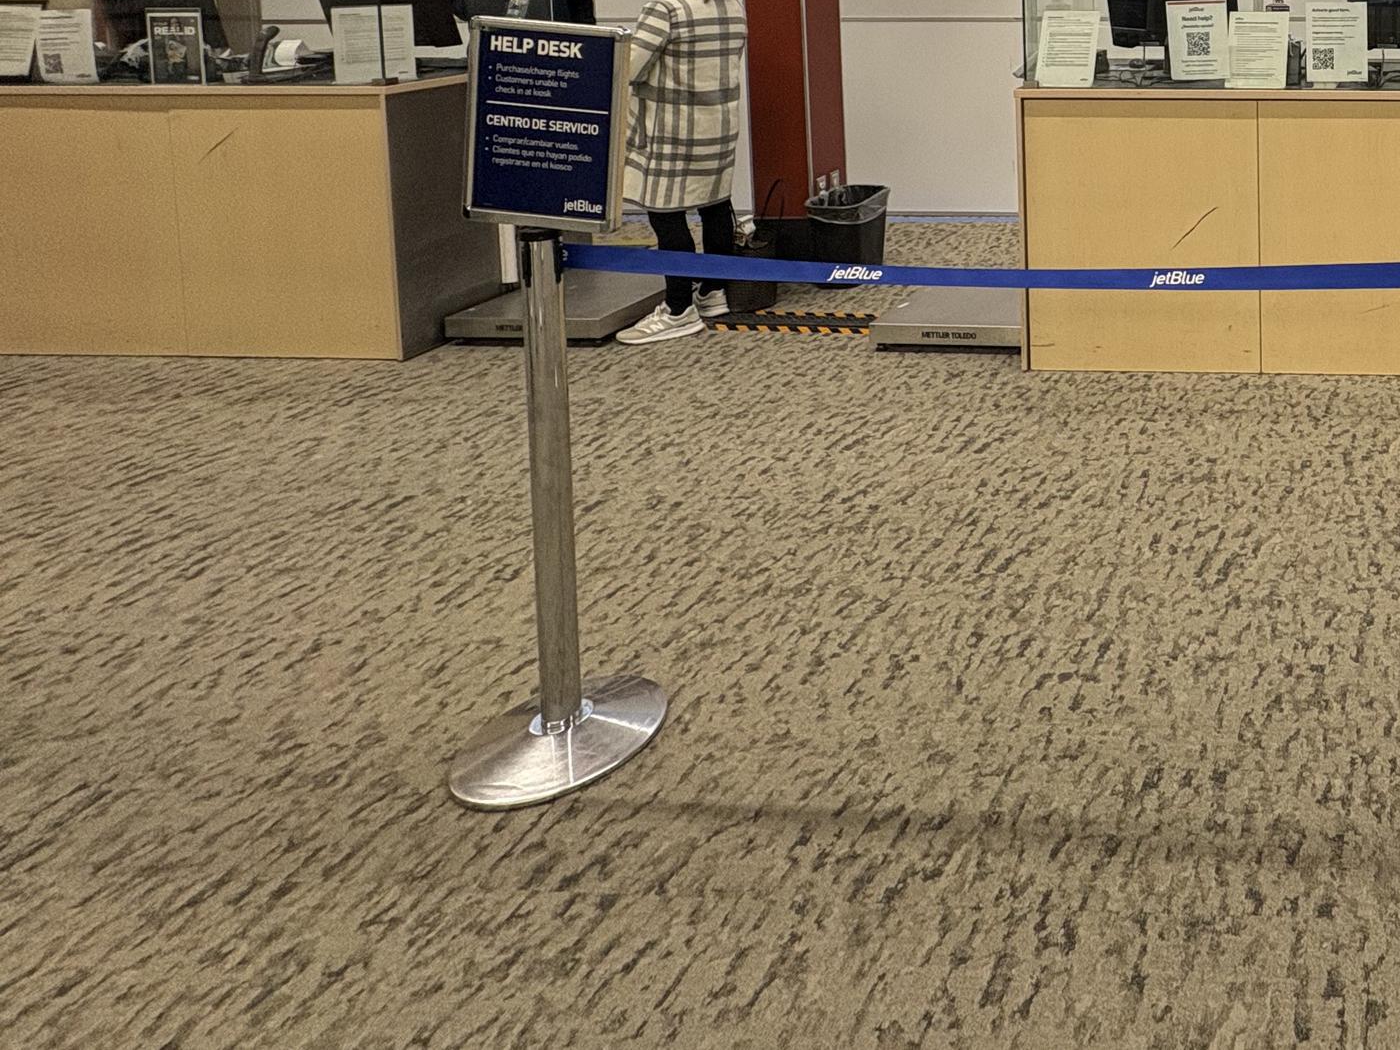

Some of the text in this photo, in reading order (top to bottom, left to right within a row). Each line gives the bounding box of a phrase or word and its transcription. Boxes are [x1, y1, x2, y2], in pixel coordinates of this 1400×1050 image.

[490, 35, 583, 59] HELP DESK
[496, 63, 580, 79] Purchase/change flights
[495, 75, 567, 88] Customers unable to
[495, 86, 515, 94] check
[516, 87, 524, 95] in
[533, 88, 552, 98] kiosk
[486, 114, 599, 135] CENTRO DE SERVICIO
[492, 134, 554, 148] Comprar/cambiar
[492, 145, 520, 155] Clientes
[521, 150, 534, 158] que
[546, 151, 567, 161] hayan
[568, 154, 592, 163] podido
[492, 156, 530, 167] registrarse
[541, 160, 549, 168] el
[549, 161, 573, 171] kiosco
[563, 198, 603, 214] jetBlue
[827, 266, 883, 281] jetBlue
[1149, 270, 1205, 288] jetBlue
